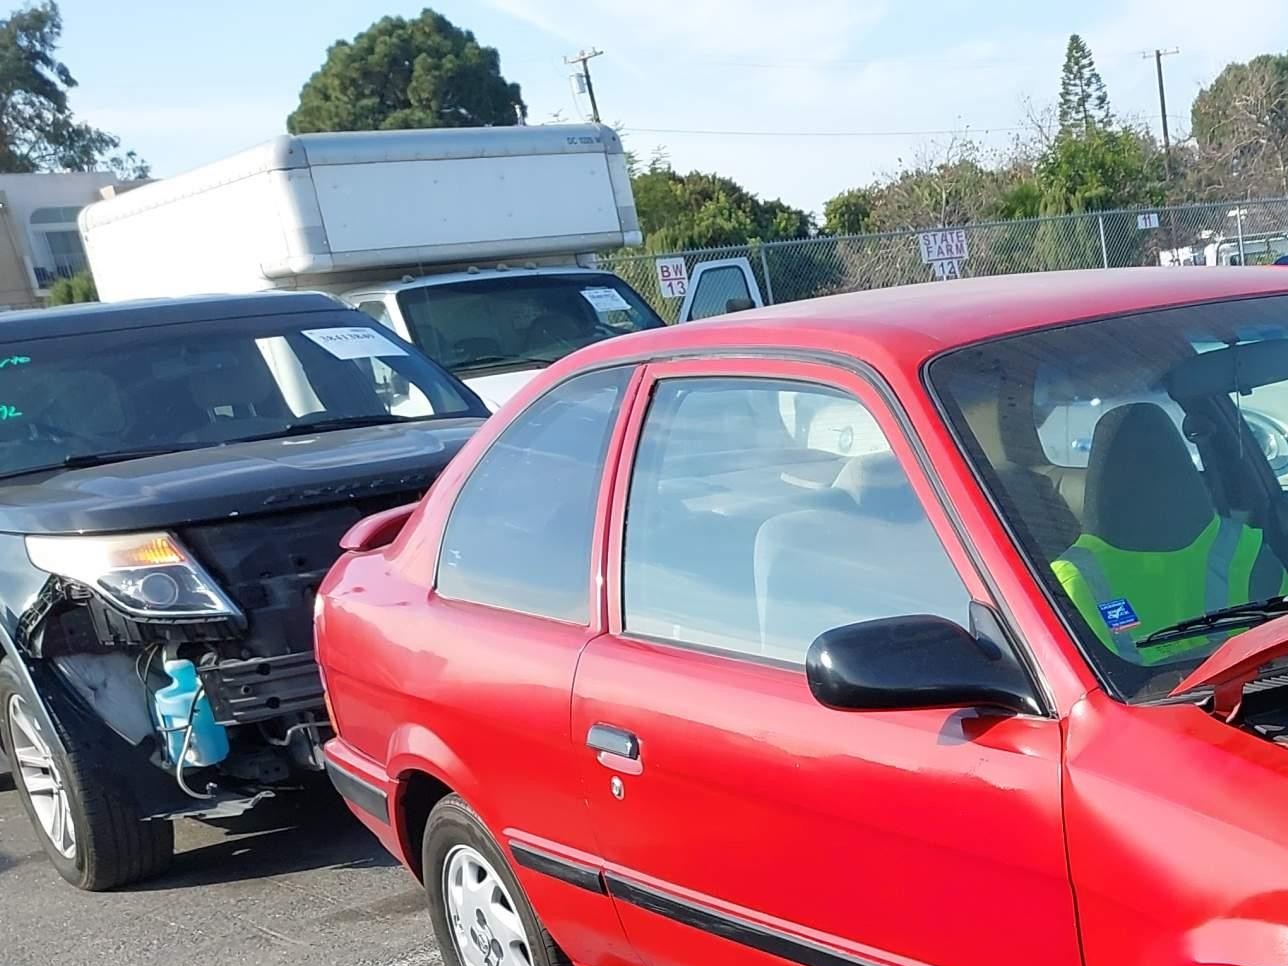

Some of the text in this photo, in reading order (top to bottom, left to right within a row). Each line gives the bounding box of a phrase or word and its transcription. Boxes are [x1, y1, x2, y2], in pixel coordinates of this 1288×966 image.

[1142, 214, 1152, 227] 11
[922, 230, 965, 246] STATE
[926, 243, 965, 258] FARM
[939, 260, 957, 275] 12
[667, 281, 687, 295] 13
